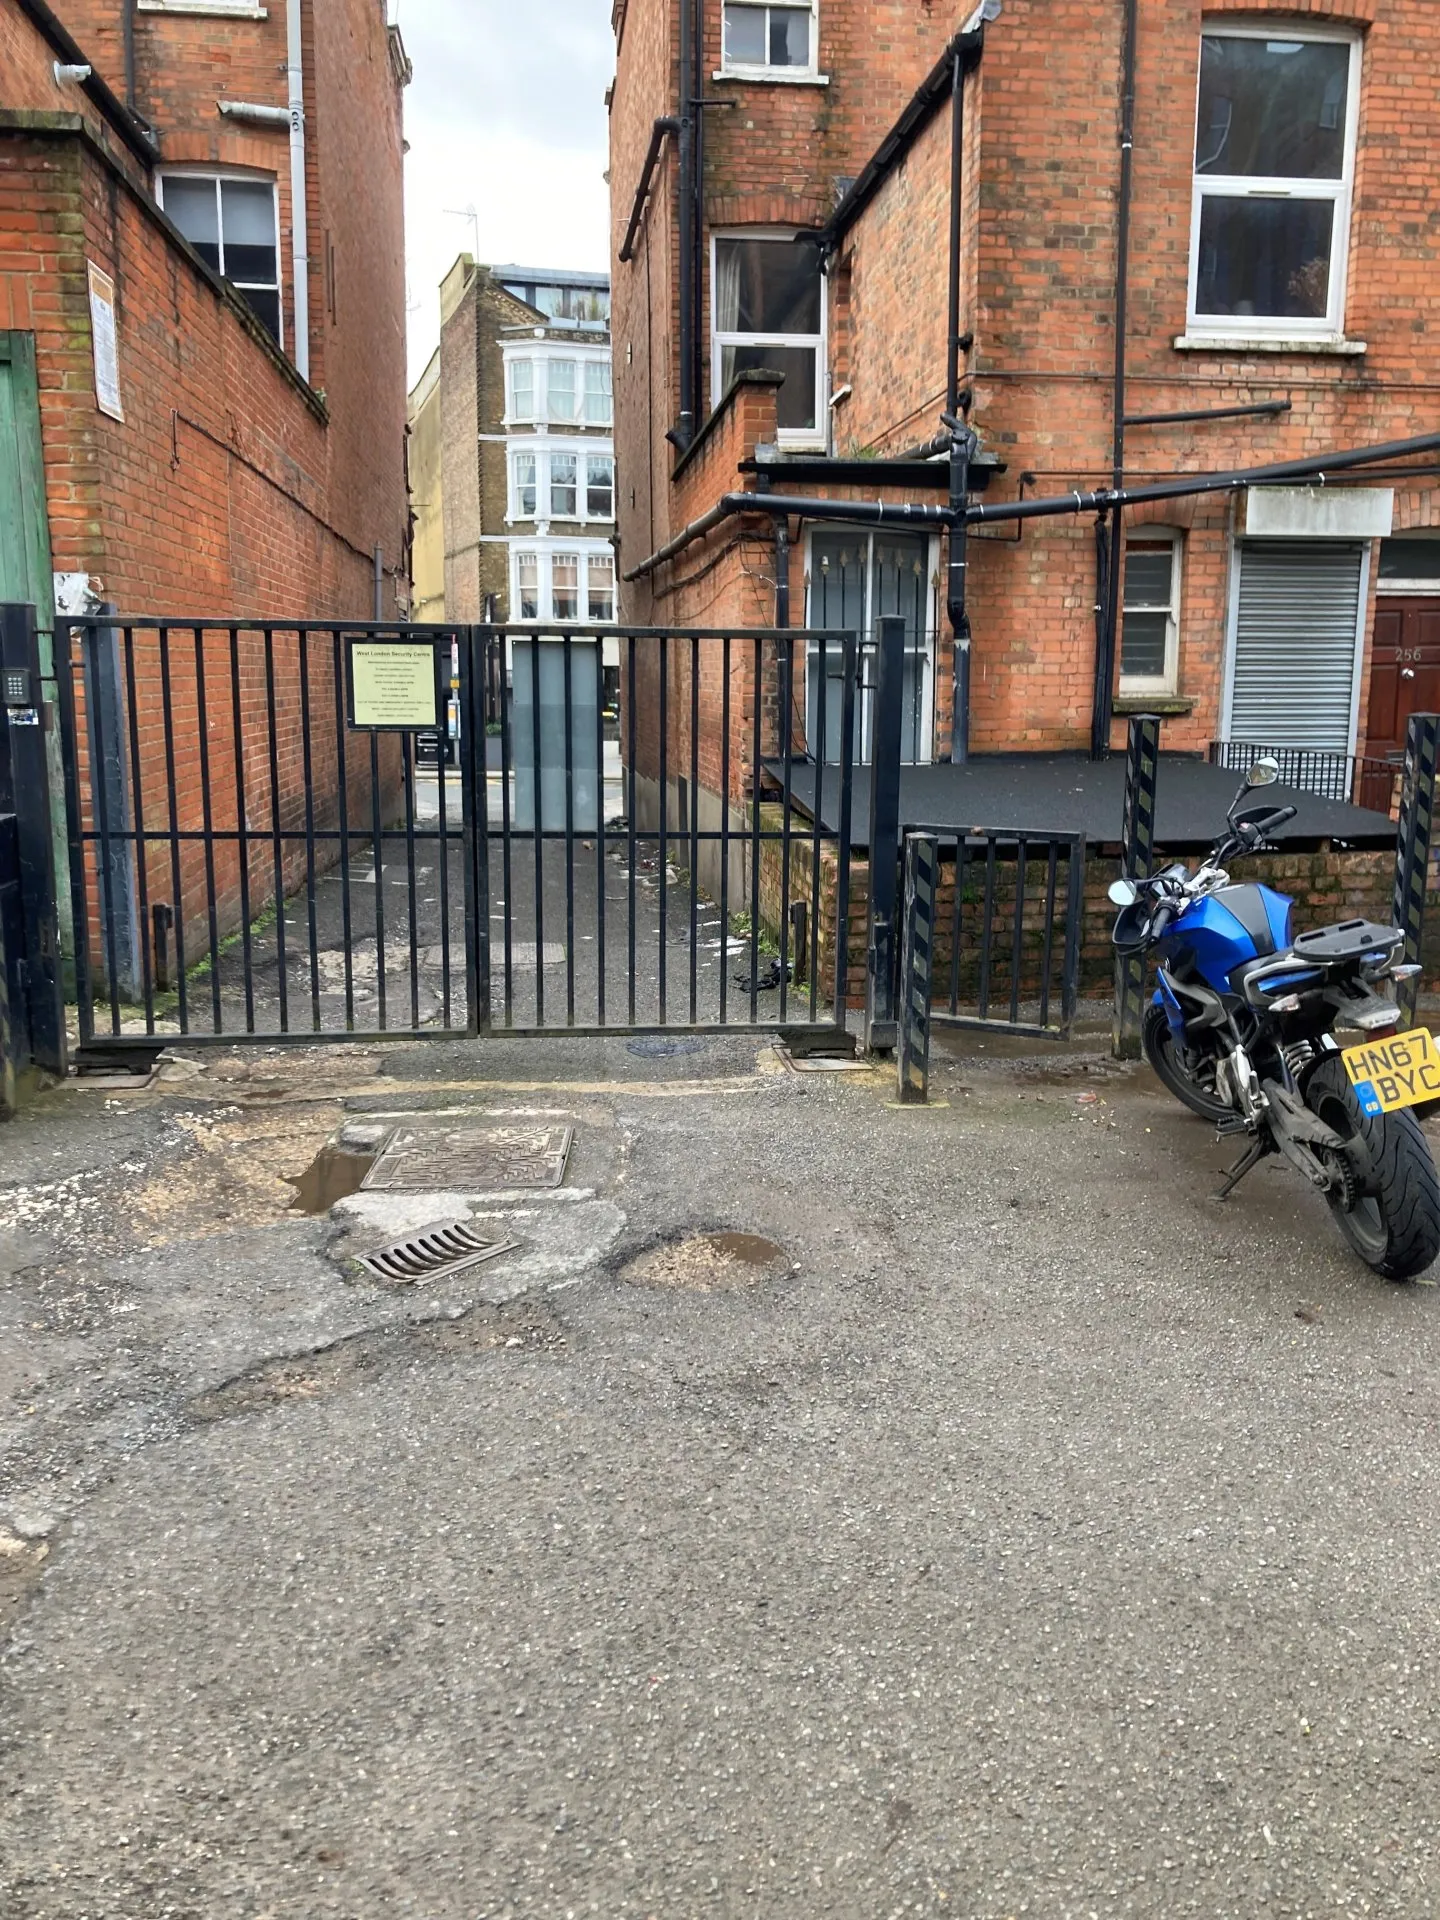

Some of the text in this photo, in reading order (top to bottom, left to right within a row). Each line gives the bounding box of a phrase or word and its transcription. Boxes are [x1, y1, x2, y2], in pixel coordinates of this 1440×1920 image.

[1395, 648, 1422, 662] 256
[1347, 1034, 1428, 1080] HN67
[1376, 1064, 1440, 1103] BYC
